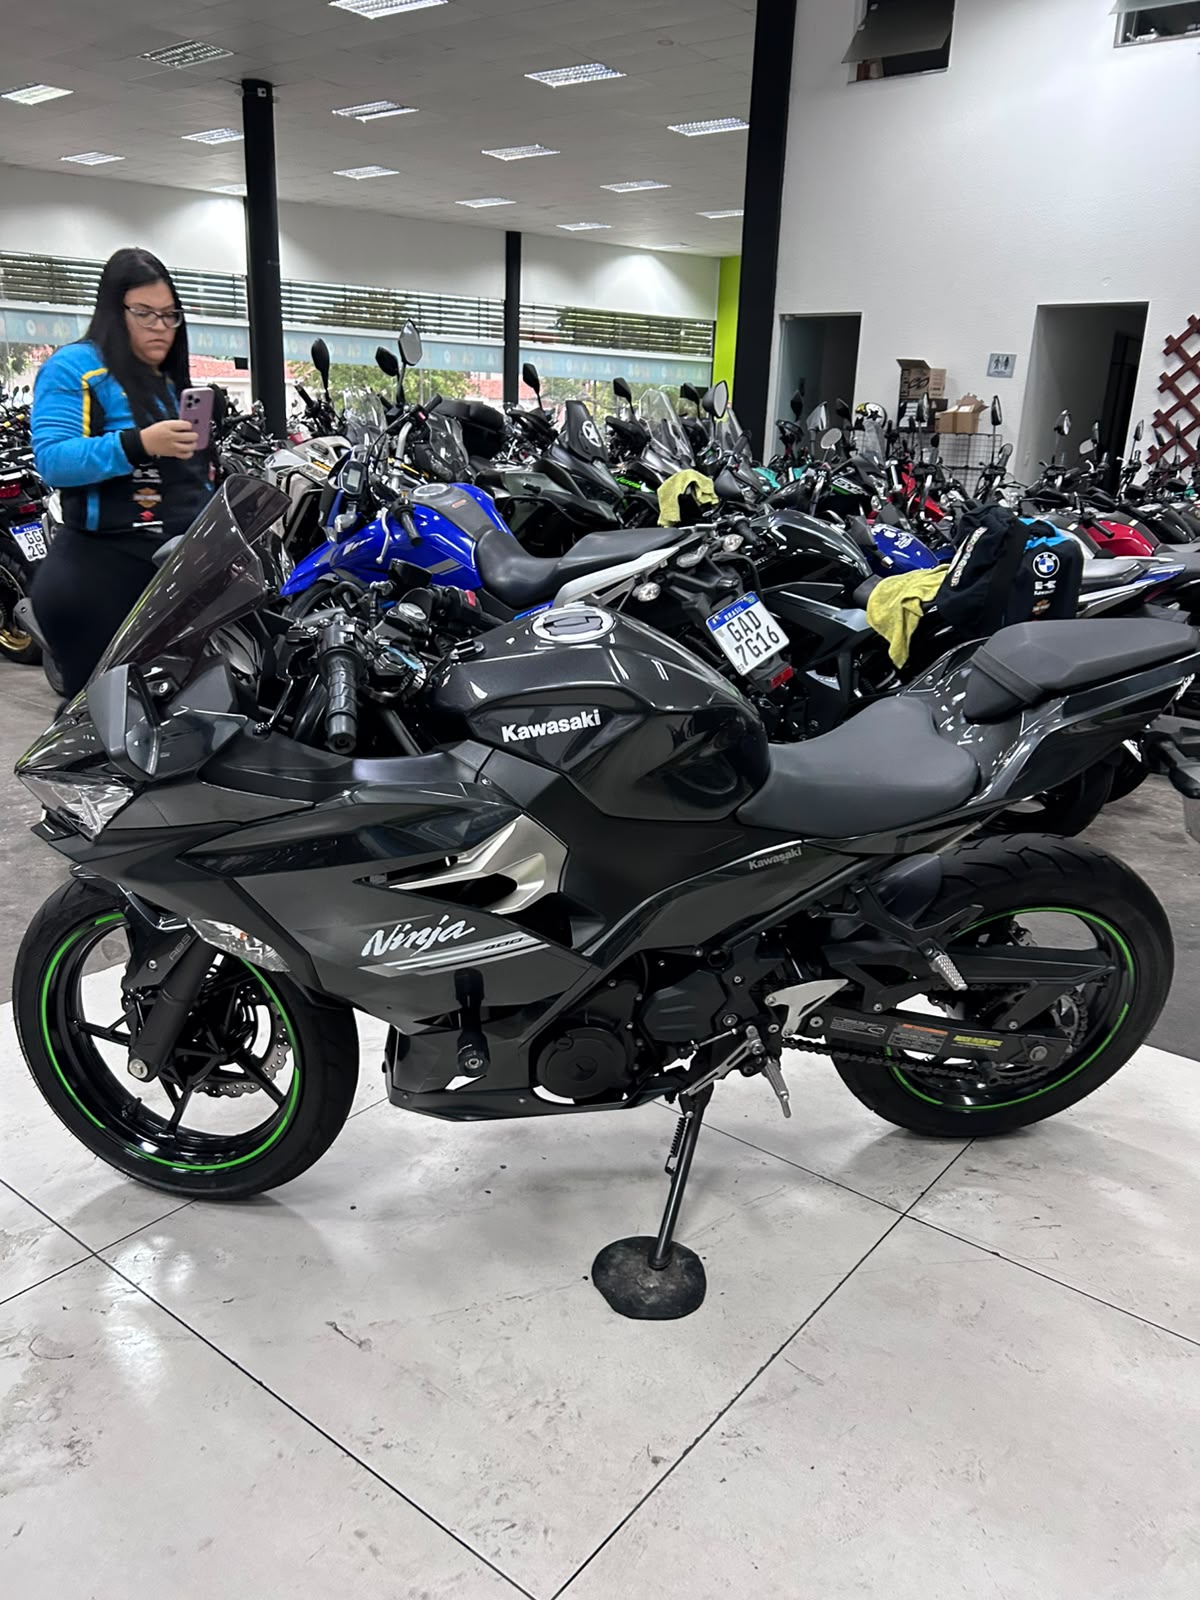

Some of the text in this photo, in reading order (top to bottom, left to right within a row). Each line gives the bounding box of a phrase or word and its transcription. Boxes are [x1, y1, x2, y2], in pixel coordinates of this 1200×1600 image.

[24, 529, 44, 545] GG
[726, 609, 762, 643] GAD
[734, 625, 780, 666] 7G16
[501, 708, 602, 743] Kawasaki
[748, 846, 802, 870] Kawasaki
[360, 914, 476, 957] Ninja
